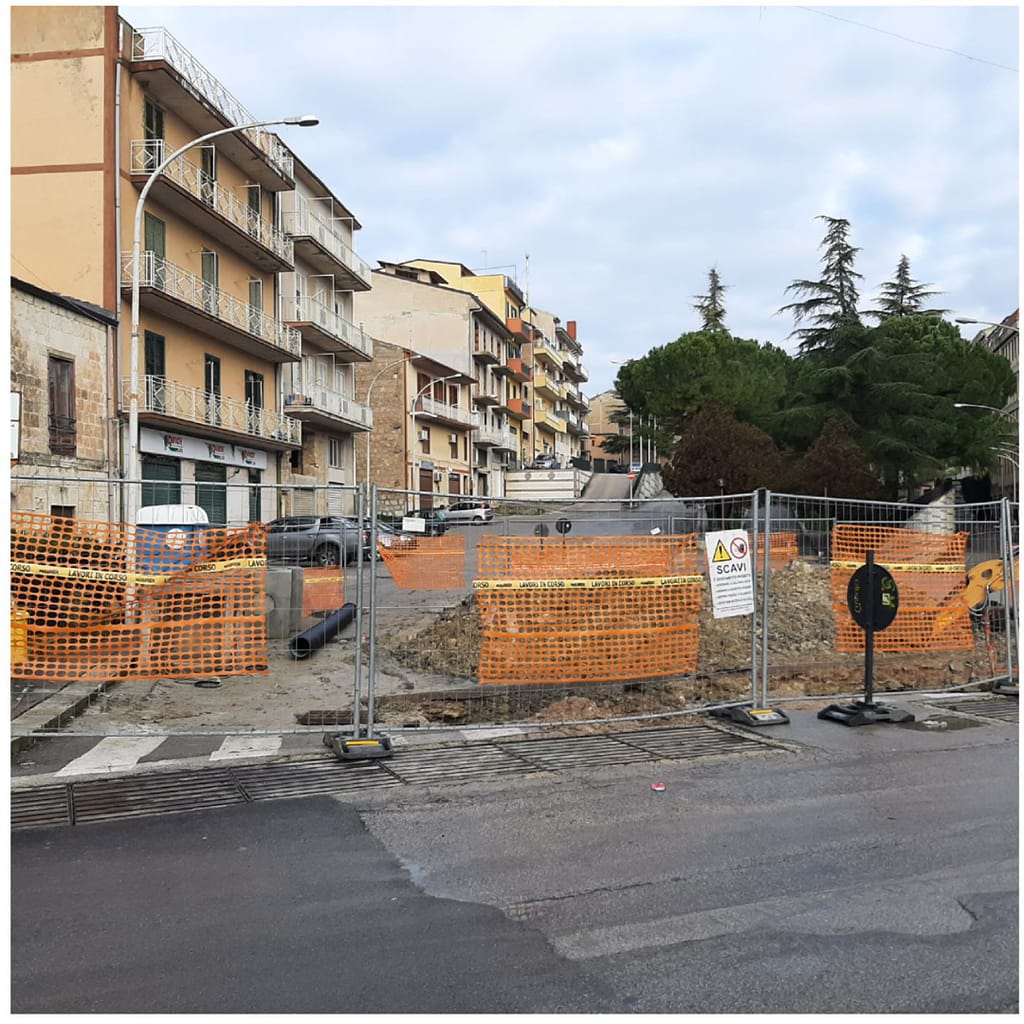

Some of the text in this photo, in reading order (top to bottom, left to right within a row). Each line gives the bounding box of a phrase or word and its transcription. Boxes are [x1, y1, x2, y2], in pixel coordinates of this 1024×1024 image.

[193, 563, 216, 572] CORSO
[716, 562, 747, 575] SCAVI
[68, 569, 93, 580] LAVORI
[95, 572, 103, 580] IN
[104, 572, 128, 582] CORSO
